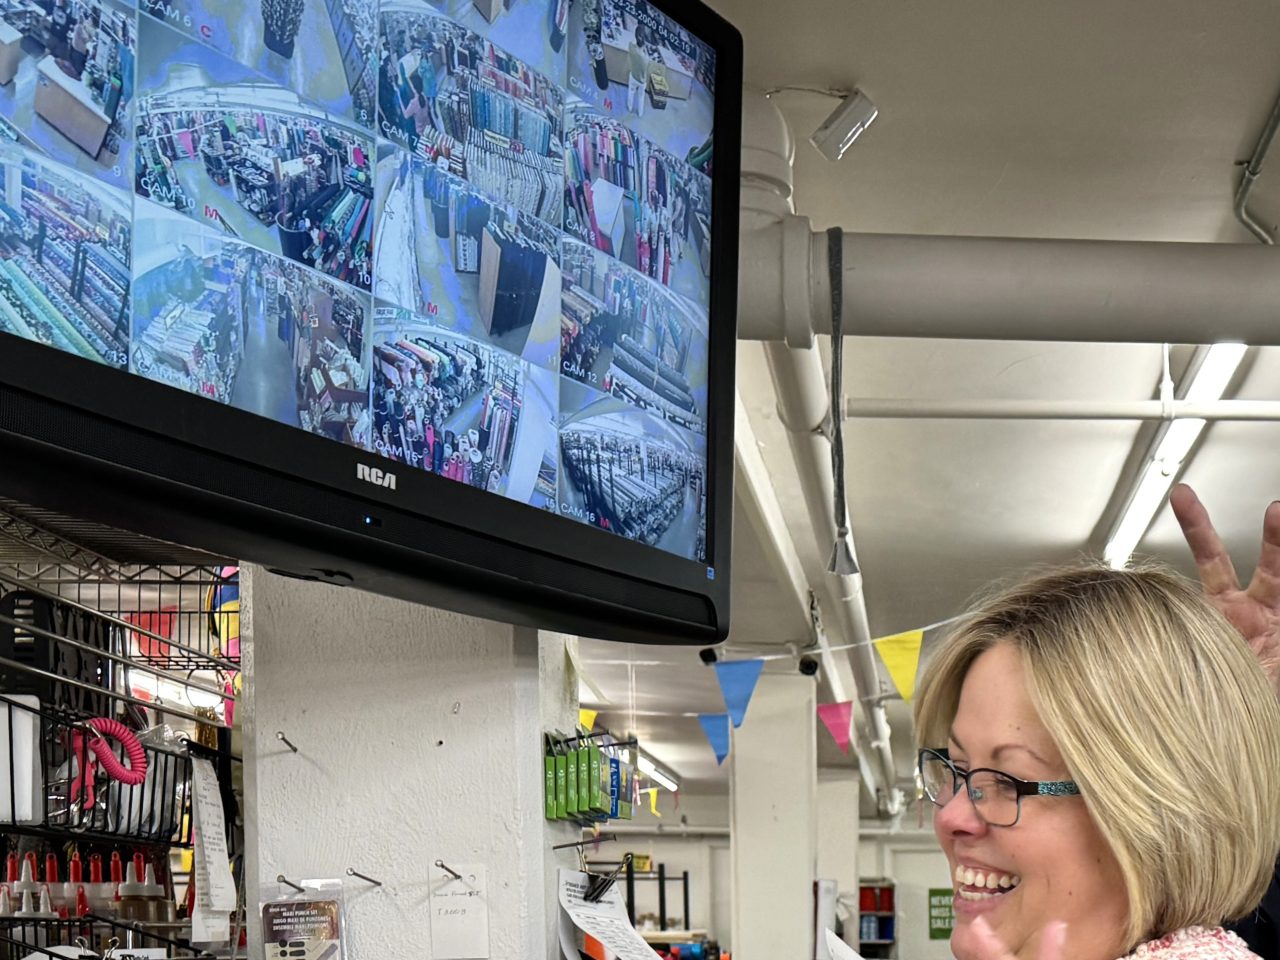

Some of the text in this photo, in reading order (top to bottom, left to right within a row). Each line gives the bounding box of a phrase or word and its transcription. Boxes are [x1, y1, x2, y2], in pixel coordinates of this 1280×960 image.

[381, 121, 409, 144] CAM
[140, 177, 177, 201] CAM
[566, 218, 587, 237] CAM
[562, 360, 598, 383] CAM 12
[375, 439, 403, 458] CAM
[357, 463, 397, 490] RCA
[560, 503, 596, 522] CAM 16
